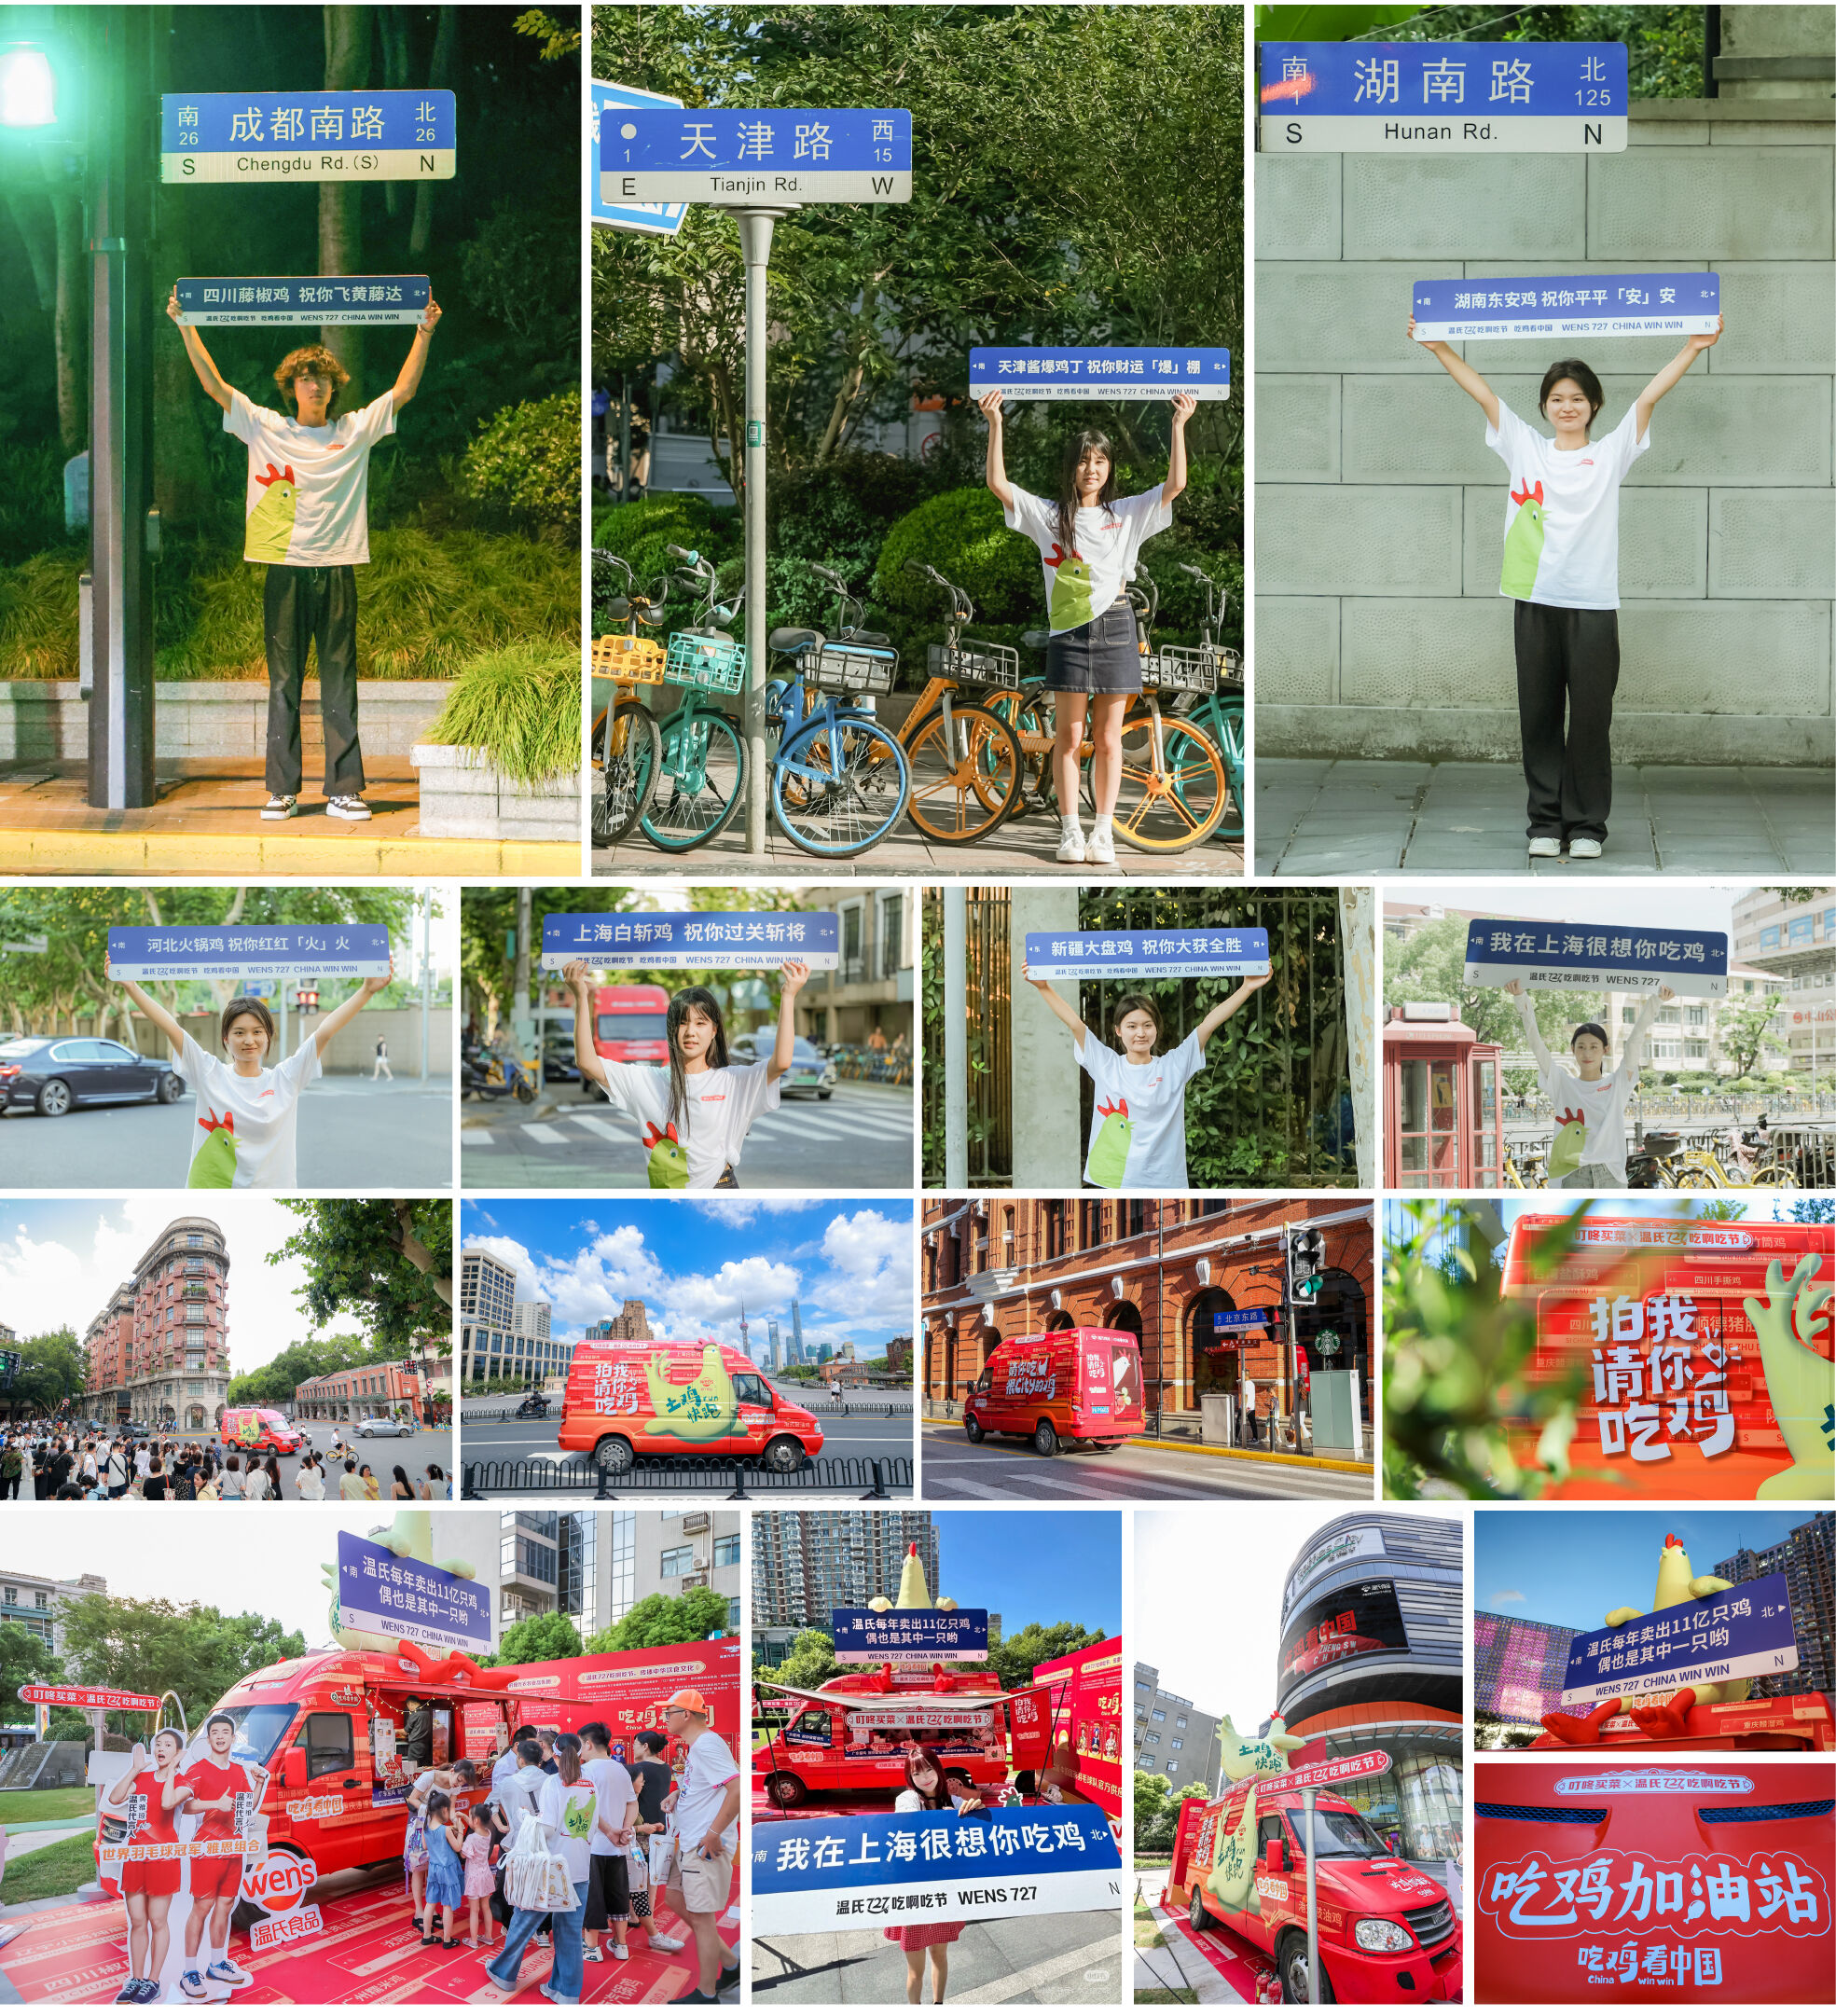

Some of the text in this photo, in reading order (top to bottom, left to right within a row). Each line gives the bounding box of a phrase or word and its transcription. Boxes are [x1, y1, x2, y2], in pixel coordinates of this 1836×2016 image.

[1282, 56, 1307, 83] 南
[1580, 57, 1607, 82] 北
[1353, 57, 1535, 104] 湖南路
[1291, 90, 1299, 105] 1
[1575, 90, 1611, 105] 125
[178, 105, 199, 127] 南
[415, 102, 436, 123] 北
[229, 104, 385, 142] 成都南路
[872, 119, 895, 142] 西
[1385, 123, 1498, 140] Hunan Rd.
[179, 131, 199, 145] 26
[416, 128, 435, 142] 26
[680, 121, 834, 161] 天津路
[1286, 123, 1303, 144] S
[1585, 123, 1602, 145] N
[421, 155, 435, 172] N
[623, 148, 631, 163] 1
[874, 148, 892, 162] 15
[182, 159, 195, 174] S
[237, 157, 311, 173] Chengdu
[623, 178, 636, 196] E
[711, 177, 802, 195] Tianjin Rd.
[872, 177, 894, 195] W
[203, 285, 403, 303] 四川藤椒鸡 祝你飞黄藤达
[1454, 286, 1677, 310] 湖南东安鸡 祝你平平「安」安
[1513, 324, 1553, 333] 吃鸡看中国
[1562, 321, 1683, 332] WENS 727 CHINA WIN WIN
[998, 360, 1201, 374] 天津酱爆鸡丁 祝你财运「爆」棚
[573, 923, 806, 942] 上海白斩鸡 祝你过关斩将
[147, 935, 351, 953] 河北火锅鸡 祝你红红「火」火
[1051, 937, 1243, 957] 新疆大盘鸡 祝你大获全胜
[1490, 932, 1705, 963] 我在上海很想你吃鸡
[294, 965, 321, 973] CHINA
[735, 956, 764, 964] CHINA
[766, 956, 784, 964] WIN
[785, 956, 804, 964] WIN
[1606, 975, 1660, 987] WENS 727
[1695, 1276, 1742, 1286] 四川手撕鸡
[1224, 1311, 1258, 1323] 北京东路
[1590, 1294, 1698, 1343] 拍我
[596, 1363, 629, 1377] 拍我
[1009, 1360, 1038, 1377] 请你吃
[1592, 1347, 1695, 1403] 请你
[595, 1379, 628, 1396] 请你
[595, 1388, 639, 1415] 吃鸡
[666, 1386, 701, 1413] 土鸡
[687, 1402, 721, 1423] 快跑
[1597, 1372, 1734, 1461] 吃鸡
[363, 1555, 477, 1610] 温氏每年卖出11亿只鸡
[379, 1585, 469, 1626] 偶也是其中一只哟
[1761, 1606, 1774, 1618] 北
[852, 1618, 971, 1630] 温氏每年卖出11亿只鸡
[1587, 1597, 1752, 1657] 温氏每年卖出11亿只鸡
[381, 1620, 468, 1648] WENS 727 CHINA WIN WIN
[865, 1632, 958, 1644] 偶也是其中一只哟
[1318, 1643, 1341, 1654] ZHENG
[1597, 1629, 1730, 1674] 偶也是其中一只哟
[1595, 1664, 1730, 1696] WENS 727 CHINA WIN WIN
[1239, 1742, 1272, 1758] 土鸡
[1255, 1758, 1282, 1772] 快跑
[127, 1795, 137, 1838] 温氏代言人
[233, 1793, 244, 1835] 温氏代言人
[288, 1799, 342, 1816] 吃鸡看中国
[1090, 1829, 1103, 1841] 北
[103, 1840, 260, 1861] 世界羽毛球冠军 雅思组合
[776, 1821, 1086, 1871] 我在上海很想你吃鸡
[1218, 1836, 1236, 1867] 土鸡
[754, 1850, 767, 1863] 南
[1225, 1857, 1244, 1881] 快跑
[958, 1886, 1037, 1905] WENS 727
[1490, 1857, 1818, 1926] 吃鸡加油站
[254, 1912, 319, 1947] 温氏食品
[1578, 1940, 1723, 1986] 吃鸡看中国
[1588, 1974, 1614, 1985] China
[1656, 1976, 1675, 1986] win
